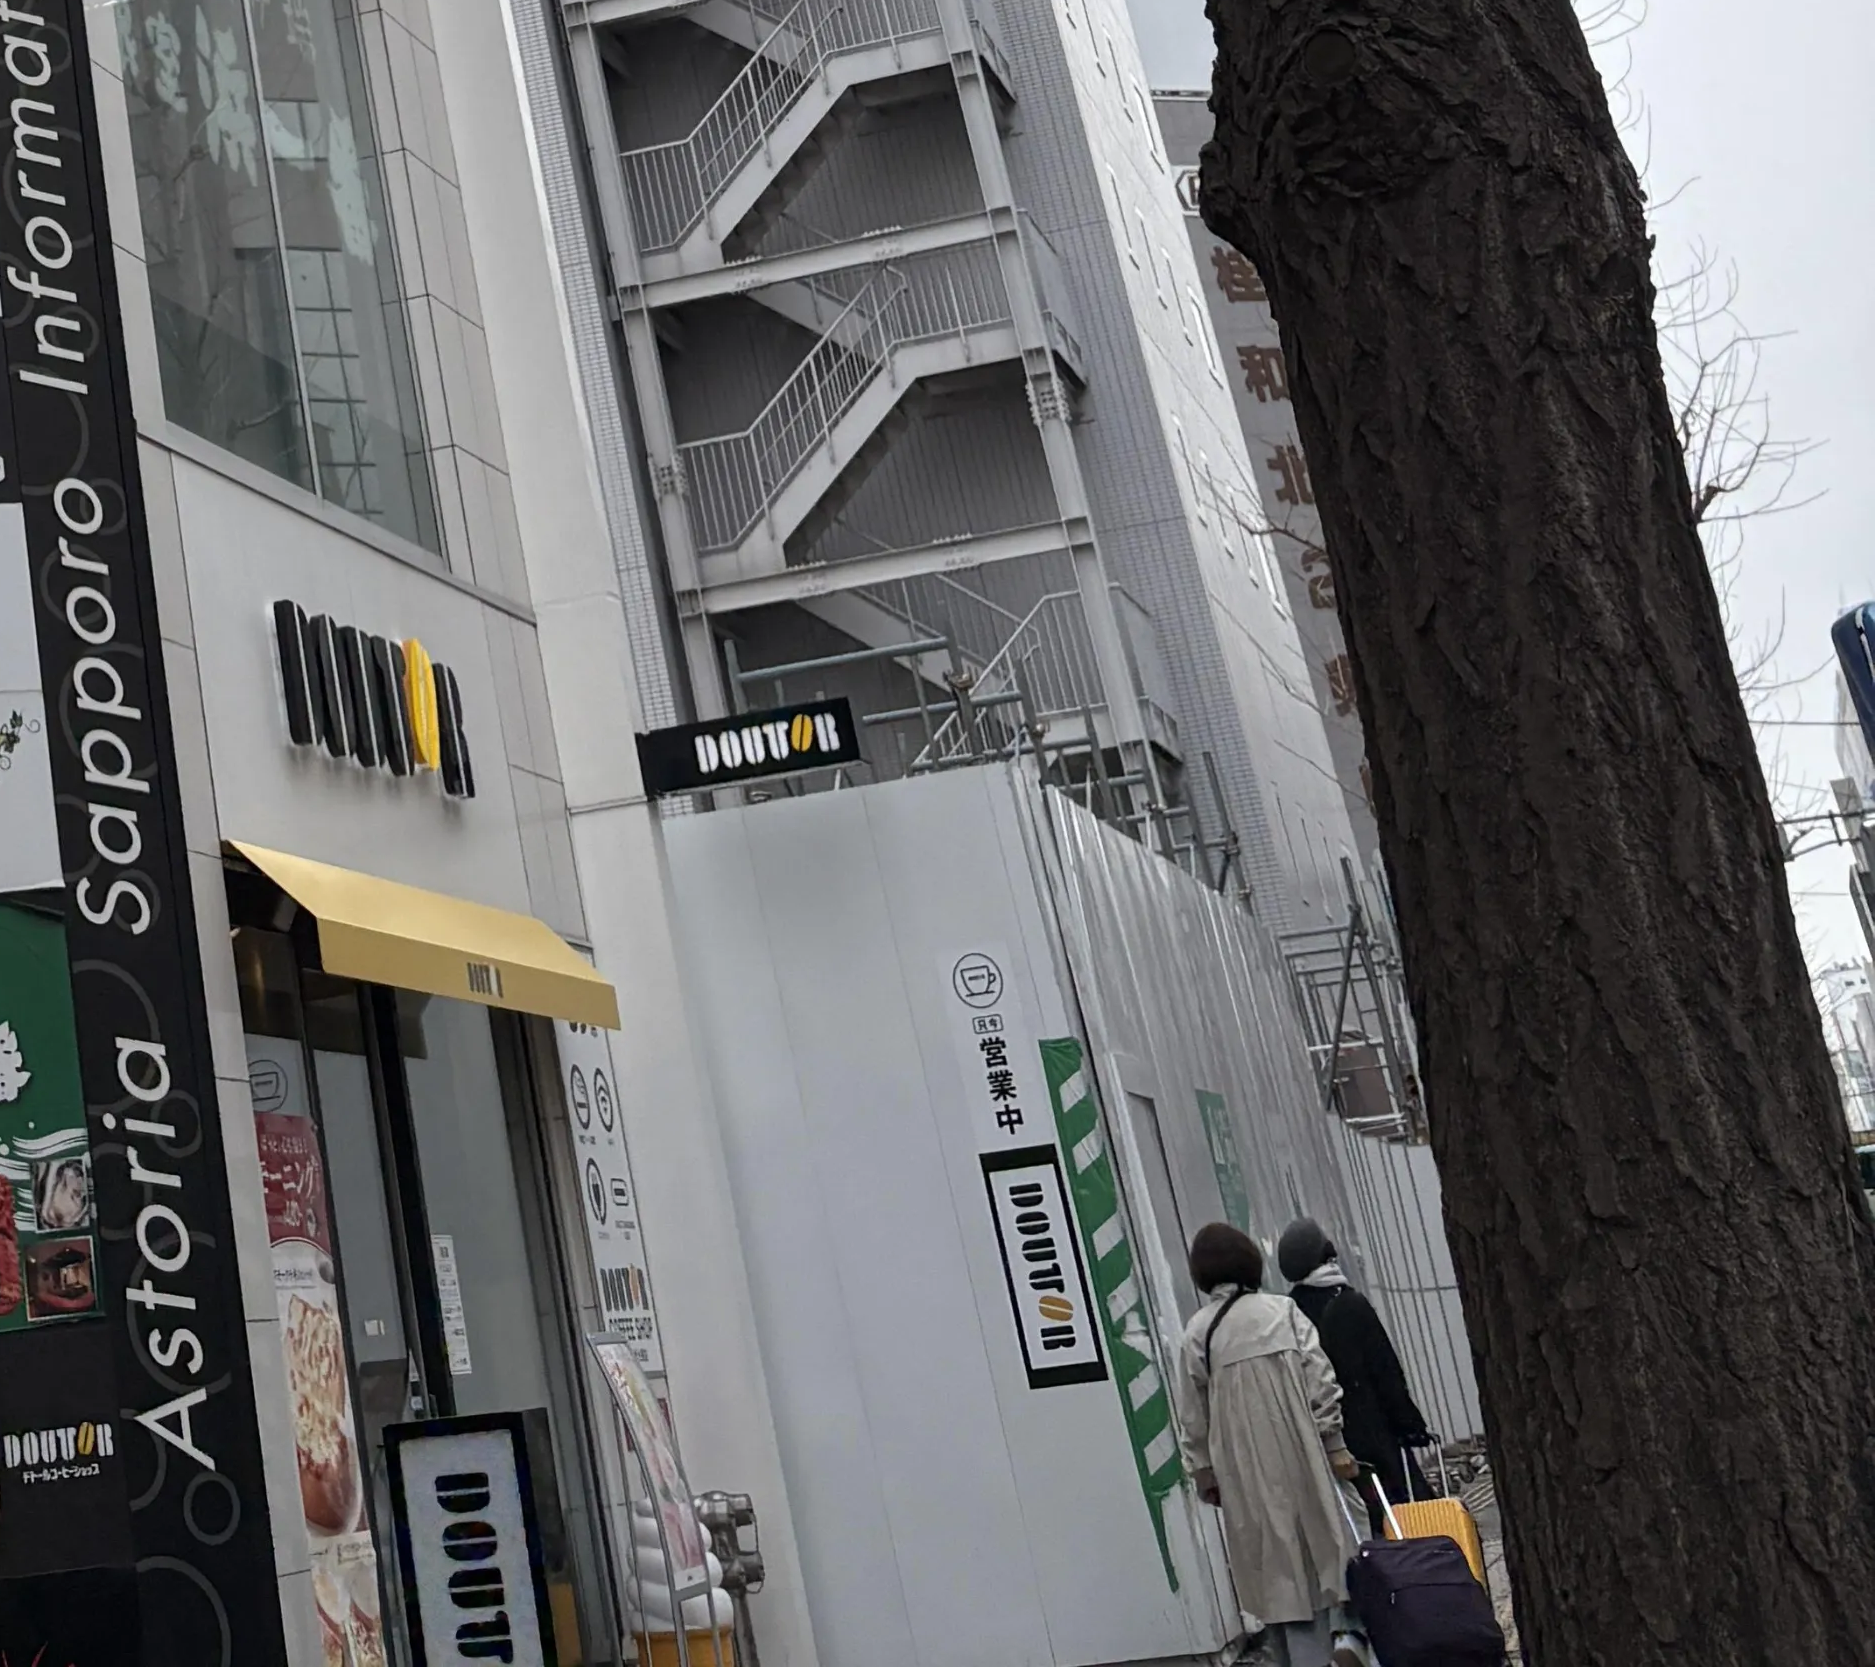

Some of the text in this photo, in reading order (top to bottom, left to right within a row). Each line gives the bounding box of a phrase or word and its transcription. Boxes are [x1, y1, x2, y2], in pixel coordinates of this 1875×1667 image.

[53, 477, 151, 935] Sapporo
[694, 713, 840, 774] DOUTOR
[979, 1036, 1024, 1135] 営業中
[102, 1036, 216, 1471] Astoria
[1009, 1183, 1076, 1350] DOUTOR
[3, 1421, 114, 1468] DOUTOR
